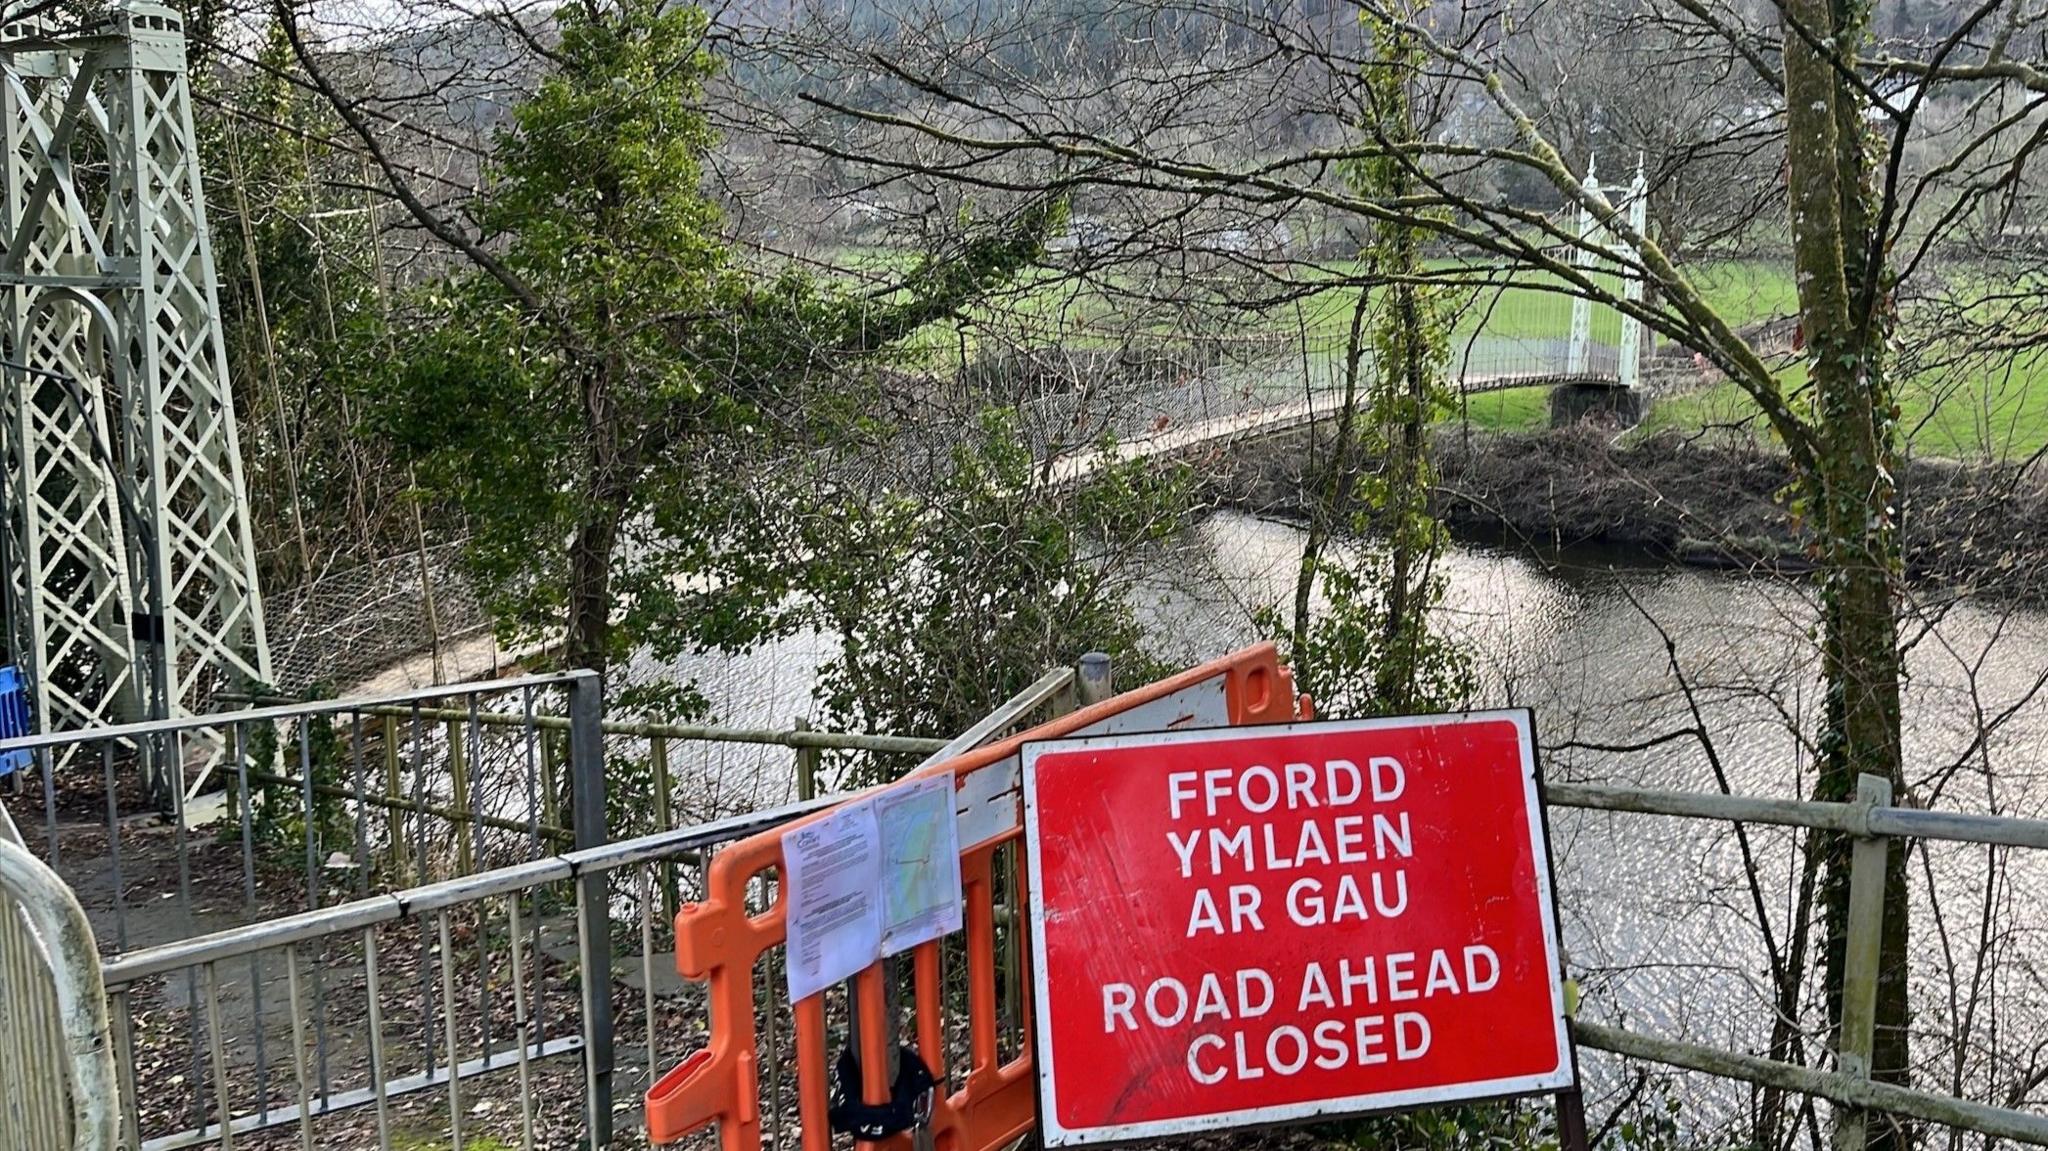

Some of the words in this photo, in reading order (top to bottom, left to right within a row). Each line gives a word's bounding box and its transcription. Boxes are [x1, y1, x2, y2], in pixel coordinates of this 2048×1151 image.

[1168, 756, 1406, 820] FFORDD
[1166, 811, 1413, 878] YMLAEN
[1186, 884, 1265, 938] AR
[1286, 869, 1408, 927] GAU
[1102, 968, 1275, 1033] ROAD
[1298, 945, 1500, 1012] AHEAD
[1187, 1012, 1431, 1085] CLOSED
